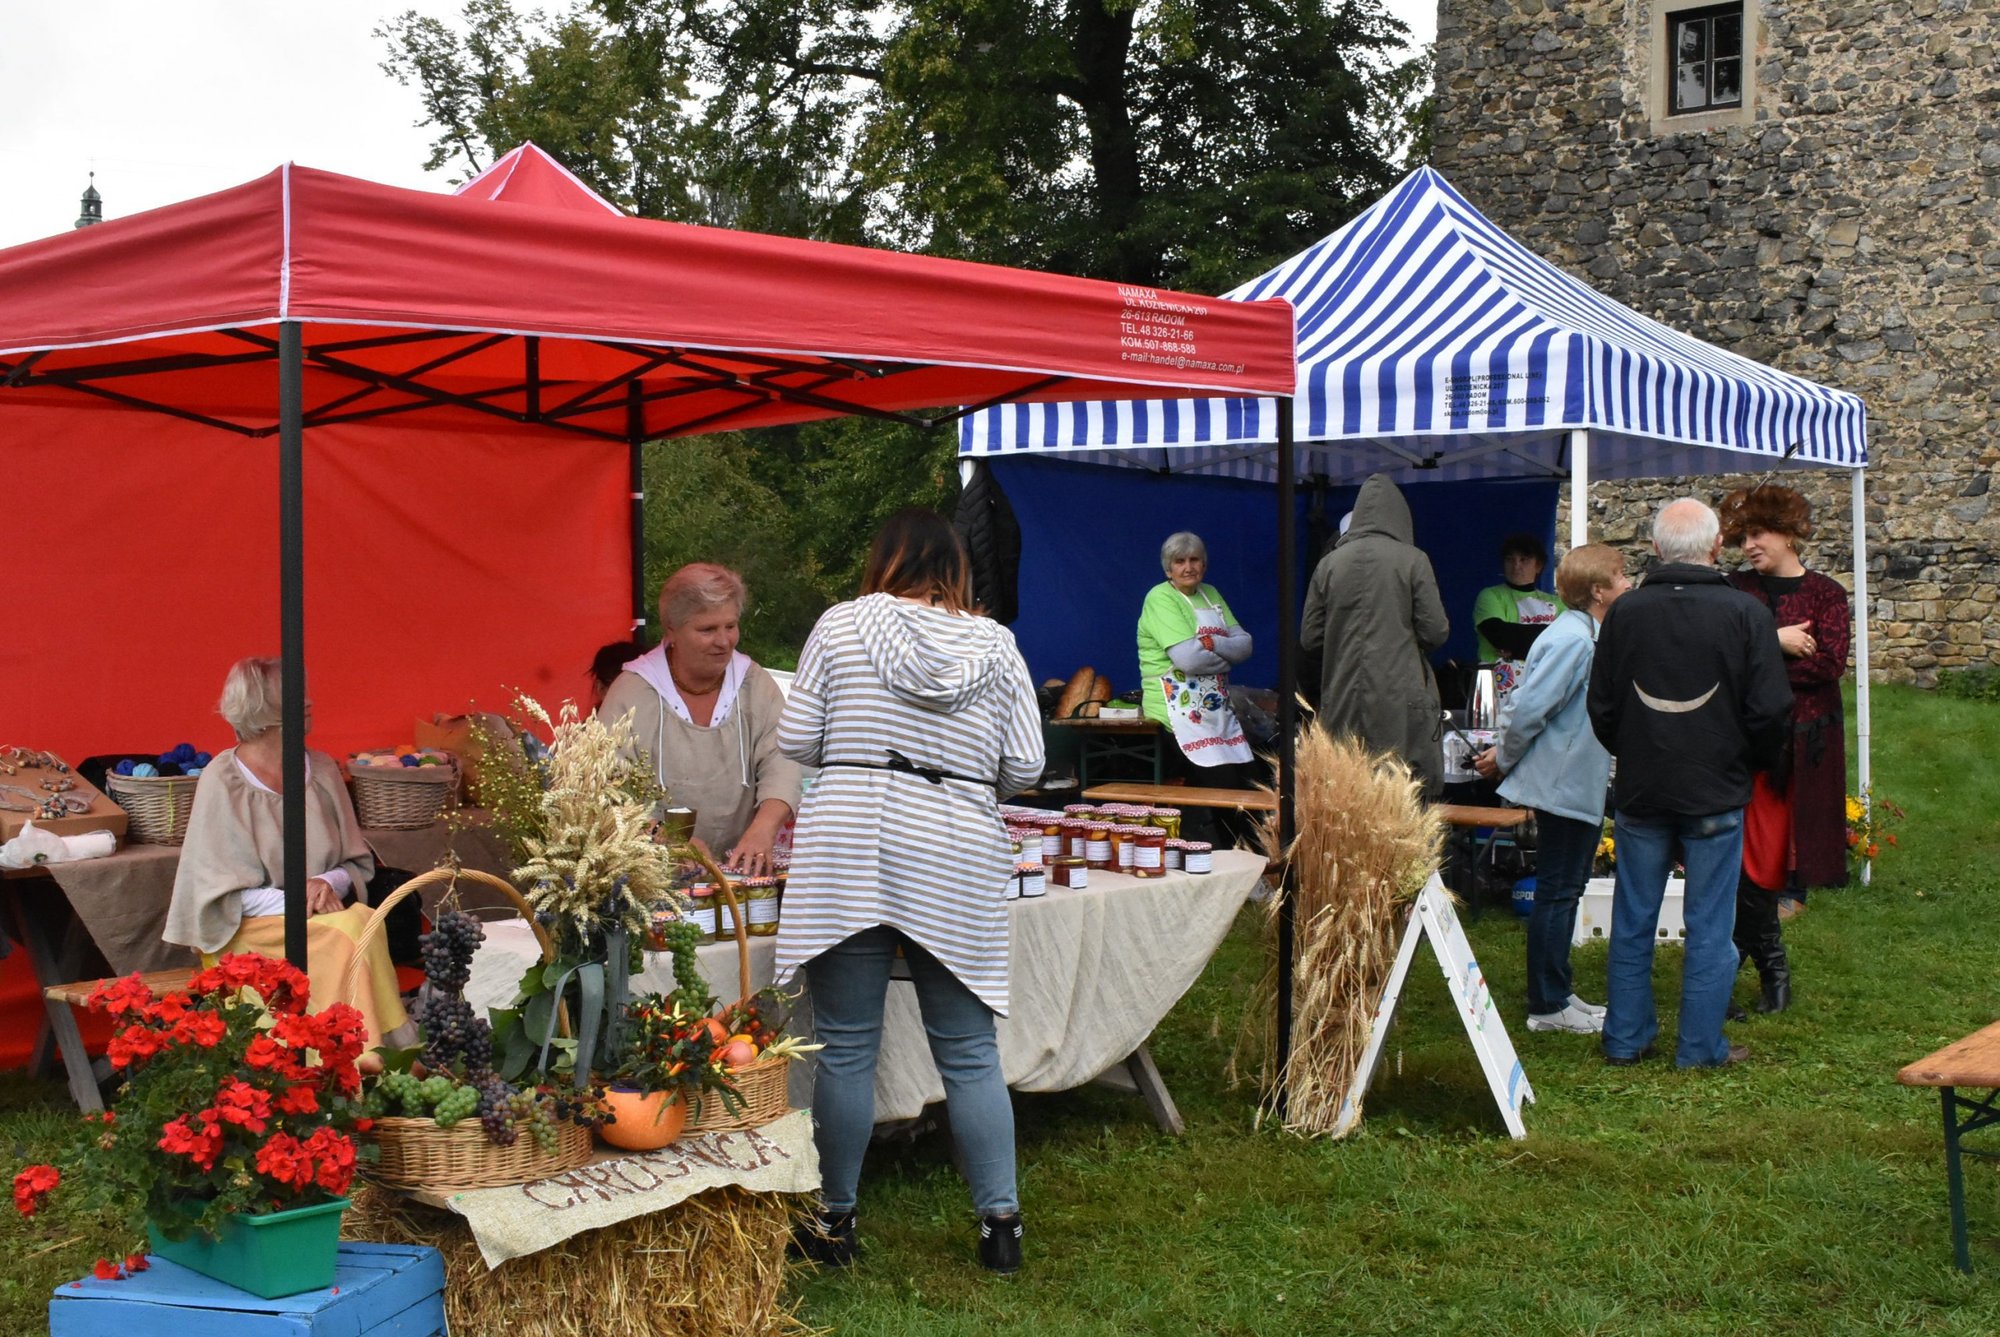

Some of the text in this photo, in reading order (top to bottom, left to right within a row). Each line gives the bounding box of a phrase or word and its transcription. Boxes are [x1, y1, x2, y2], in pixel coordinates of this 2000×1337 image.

[1118, 287, 1158, 300] NAMAXA
[1121, 309, 1185, 326] 26-613 RADOM
[1120, 322, 1194, 341] TEL.48 326-21-66
[1465, 391, 1487, 399] RADOM
